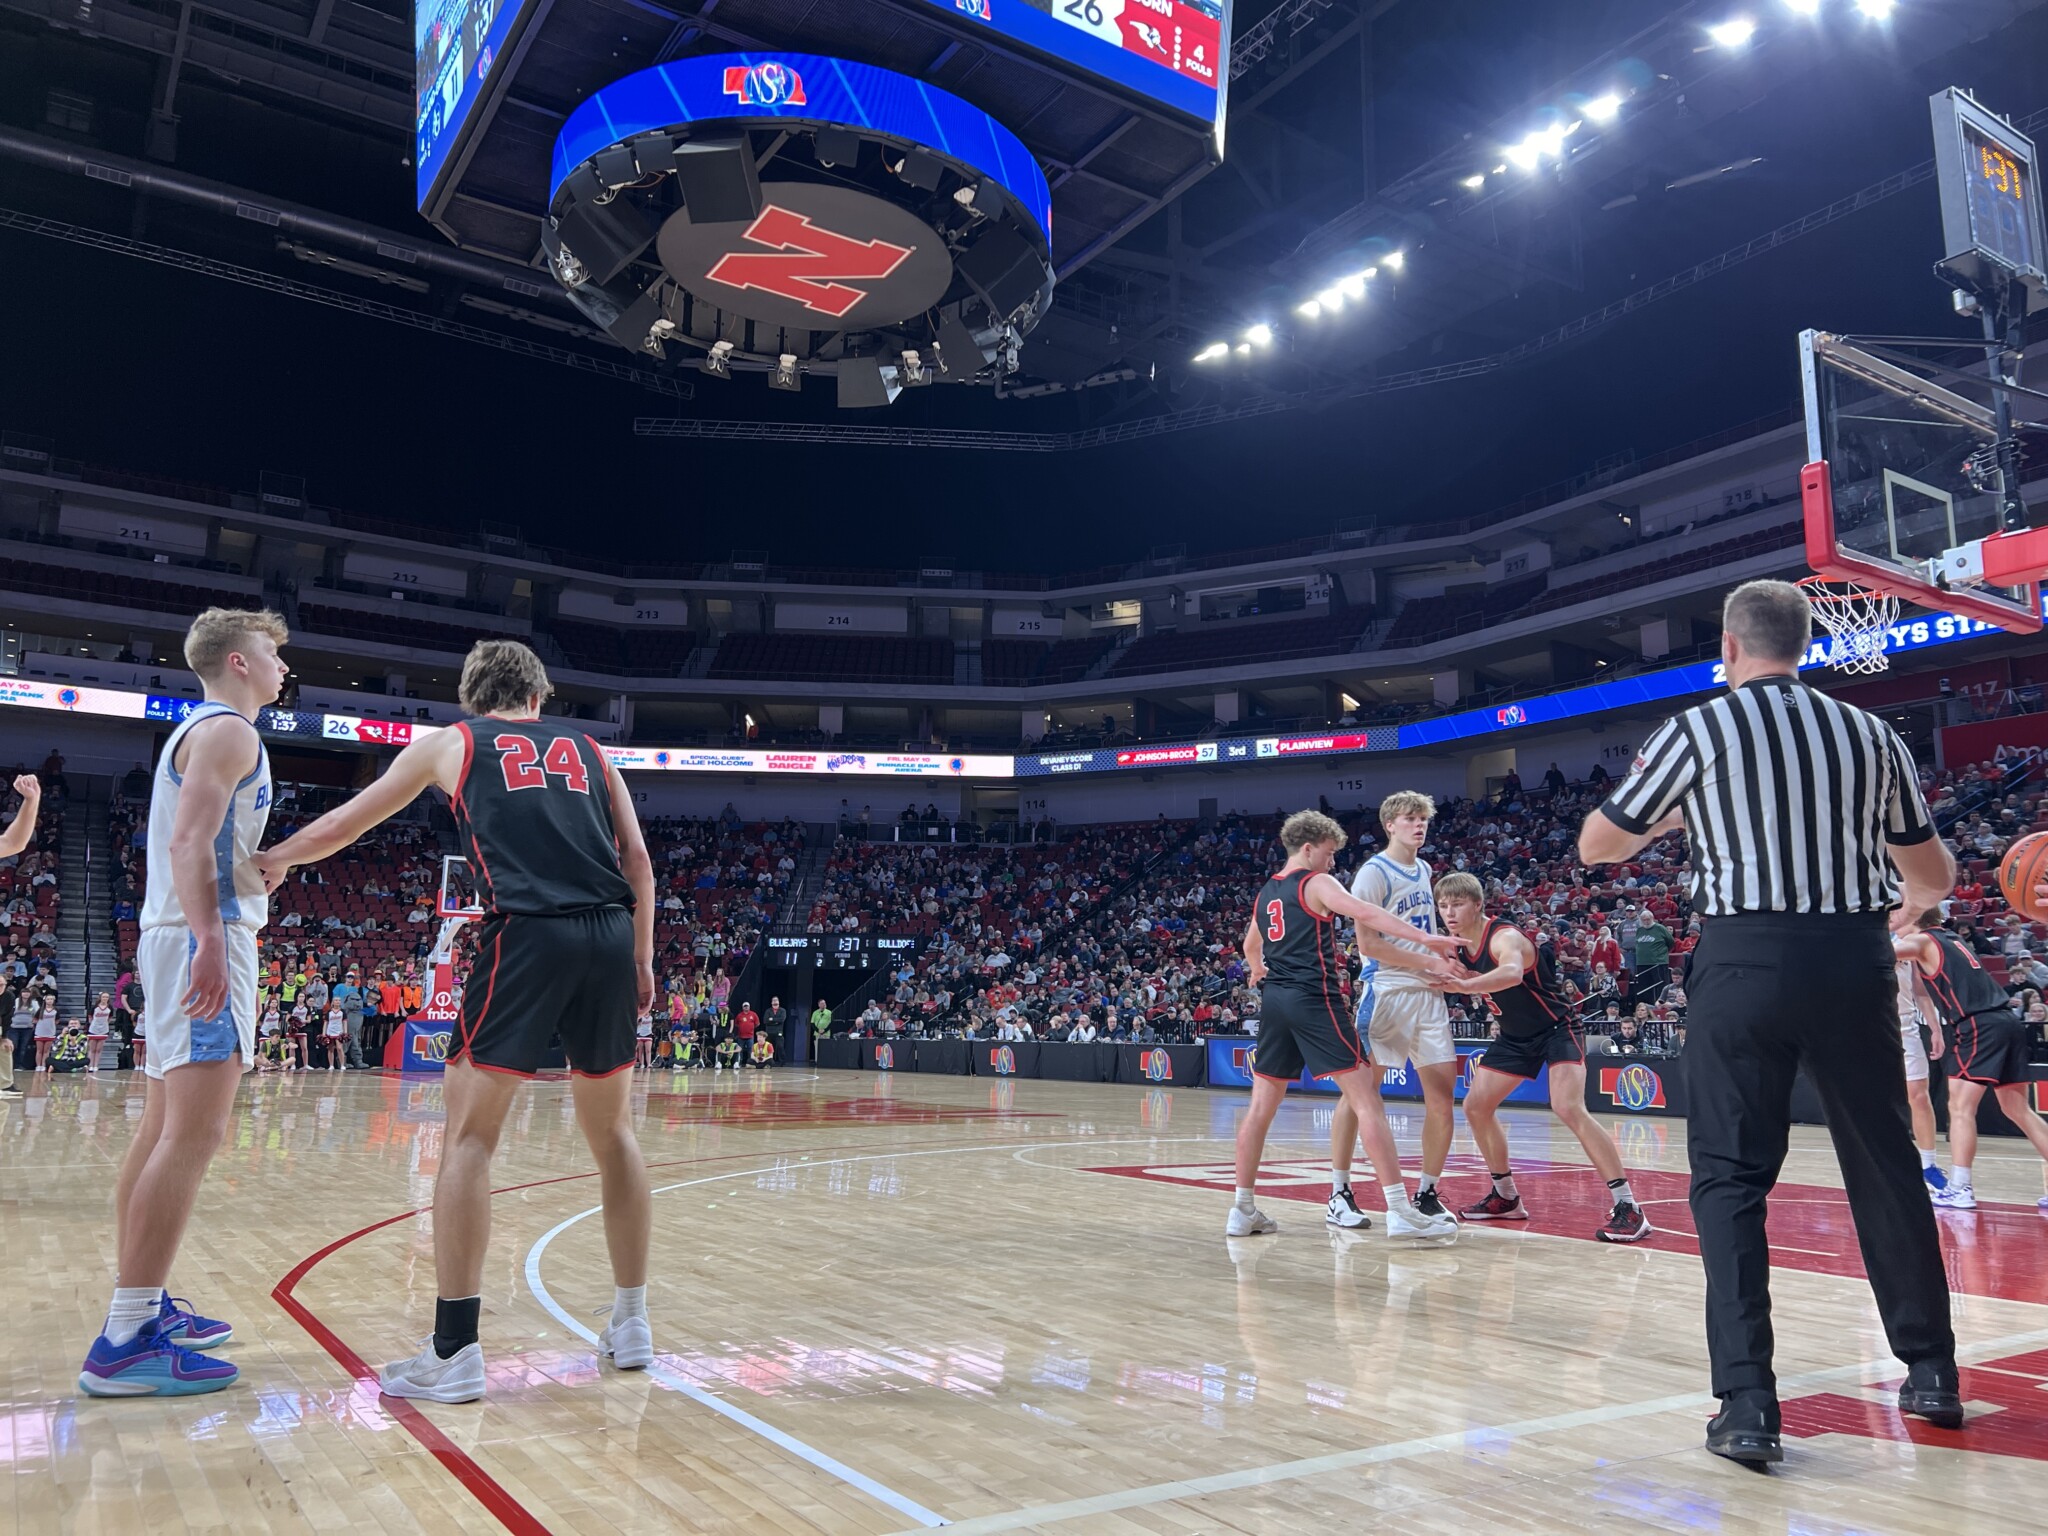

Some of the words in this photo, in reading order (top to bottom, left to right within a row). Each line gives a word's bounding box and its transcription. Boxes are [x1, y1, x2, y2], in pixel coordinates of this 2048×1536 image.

[1193, 45, 1204, 62] 4
[1185, 57, 1213, 78] FOULS
[1726, 489, 1753, 507] 218
[119, 527, 151, 542] 211
[1506, 558, 1526, 573] 217
[392, 571, 418, 584] 212
[1305, 588, 1329, 600] 216
[636, 610, 659, 620] 213
[828, 616, 850, 625] 214
[1019, 621, 1041, 631] 215
[1960, 680, 1998, 697] 117
[152, 701, 160, 709] 4
[275, 712, 293, 721] 3rd
[271, 719, 297, 732] 1:37
[328, 720, 350, 735] 26
[398, 728, 405, 736] 4
[1261, 743, 1272, 753] 31
[1280, 739, 1334, 750] PLAINVIEW
[1133, 750, 1194, 762] JOHNSON-BROCK
[1202, 748, 1214, 757] 57
[1229, 746, 1246, 756] 3rd
[1603, 744, 1629, 759] 116
[493, 734, 590, 796] 24
[1040, 756, 1069, 765] DEVANEY
[1069, 754, 1093, 763] SCORE
[1051, 764, 1073, 772] CLASS
[1337, 779, 1363, 791] 115
[1025, 800, 1046, 810] 114
[1267, 898, 1285, 942] 3
[769, 938, 808, 948] BLUEJAYS
[839, 937, 860, 951] 1:37
[786, 952, 797, 965] 11
[1953, 941, 1981, 969] 1
[816, 959, 822, 967] 2
[840, 959, 845, 967] 3
[427, 1008, 458, 1020] fnbo
